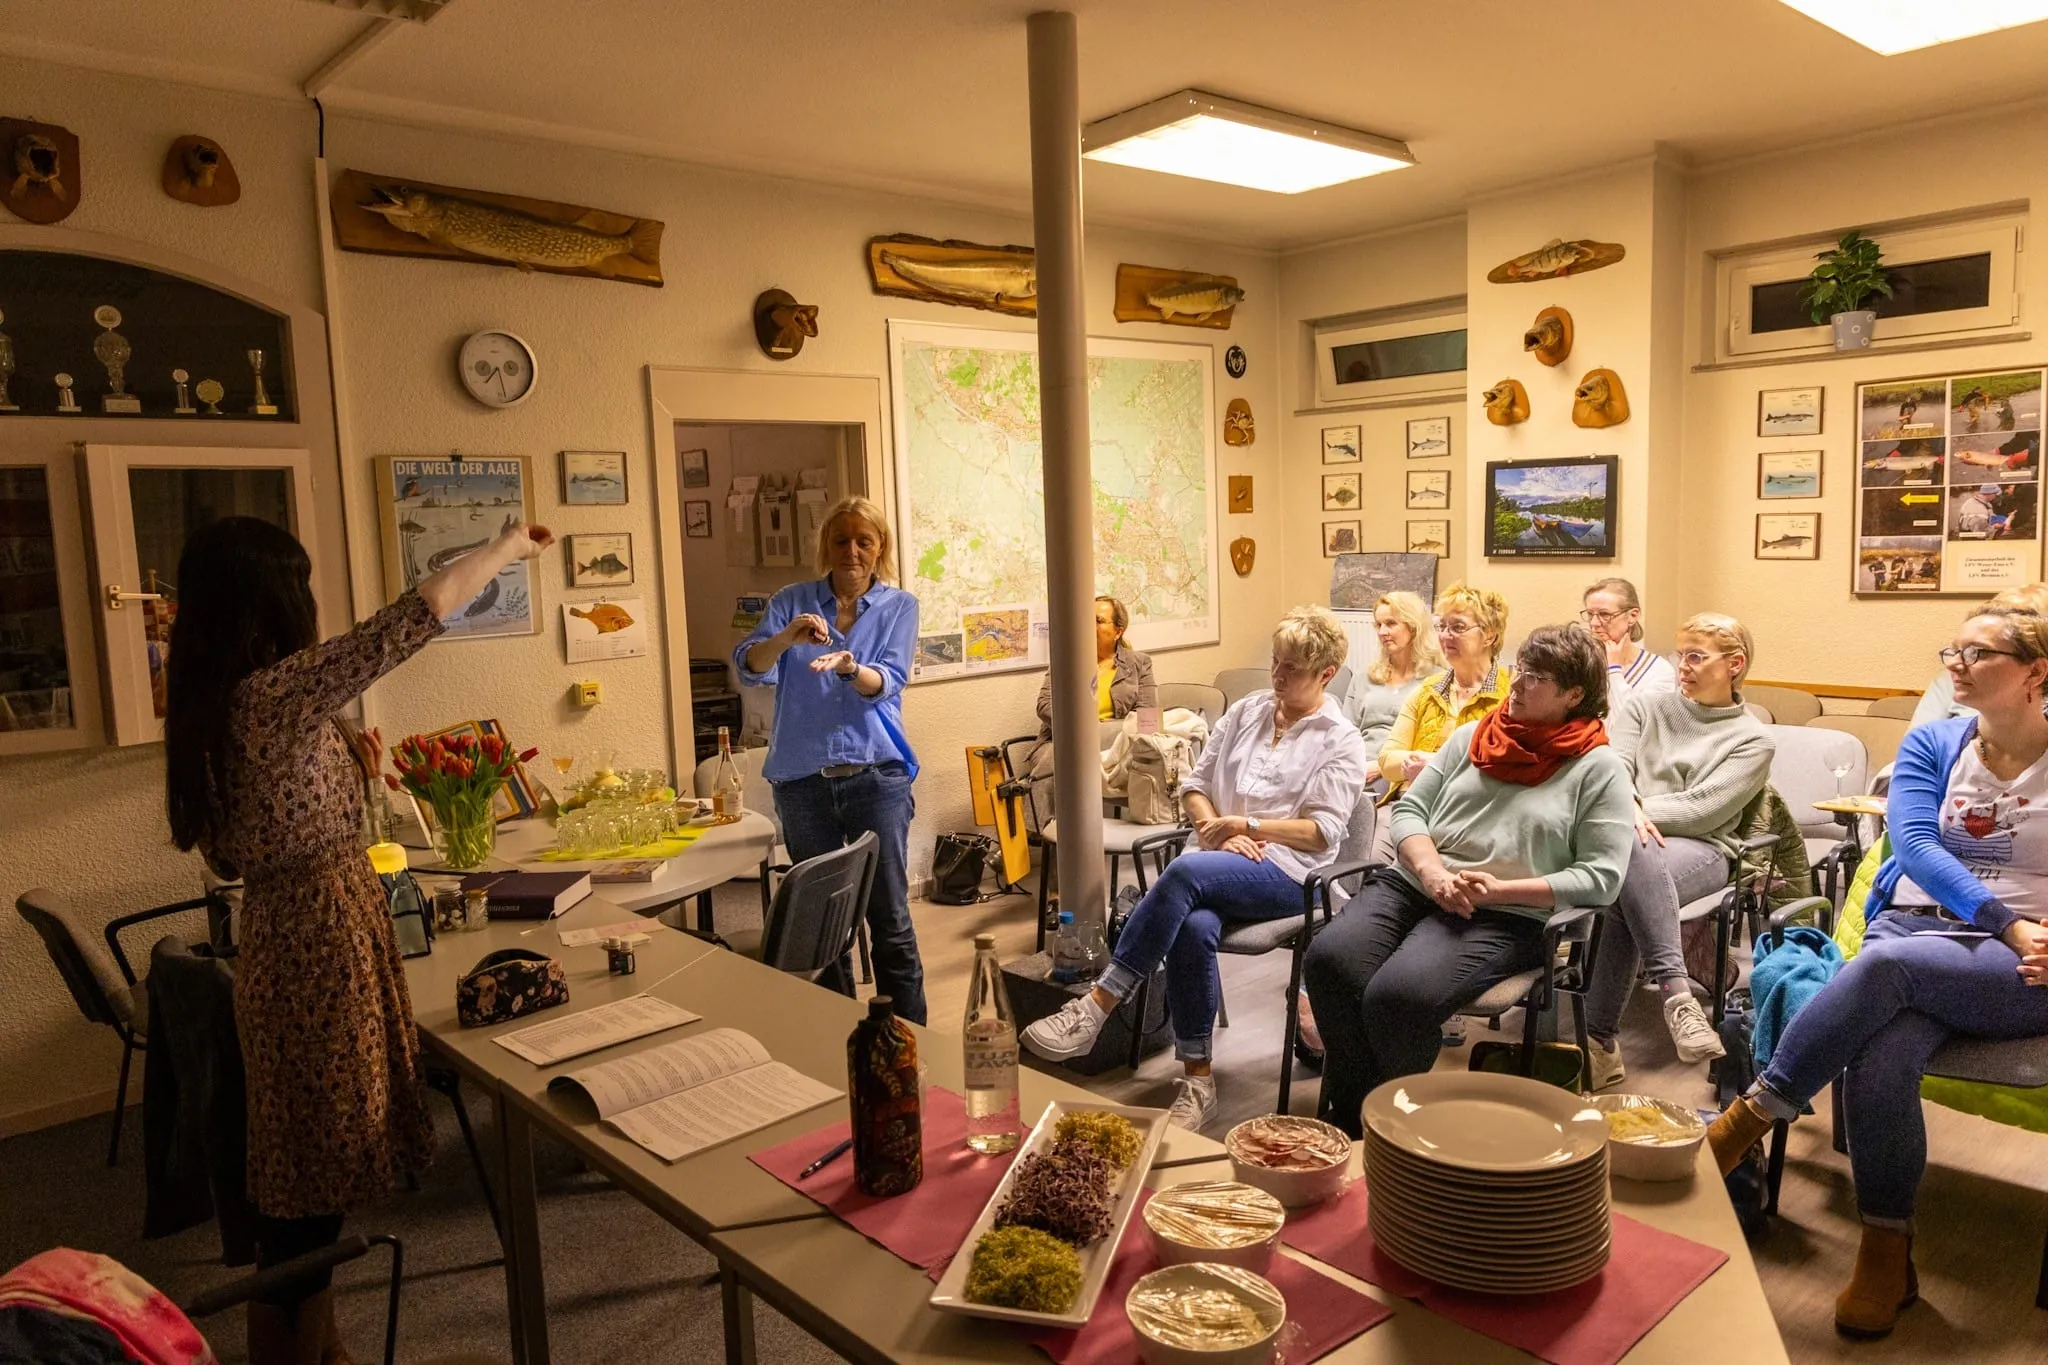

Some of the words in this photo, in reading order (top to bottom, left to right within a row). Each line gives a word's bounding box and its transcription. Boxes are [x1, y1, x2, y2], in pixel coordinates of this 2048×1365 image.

[395, 462, 418, 475] DIE
[421, 462, 456, 475] WELT
[460, 462, 484, 475] DER
[487, 462, 518, 475] AALE
